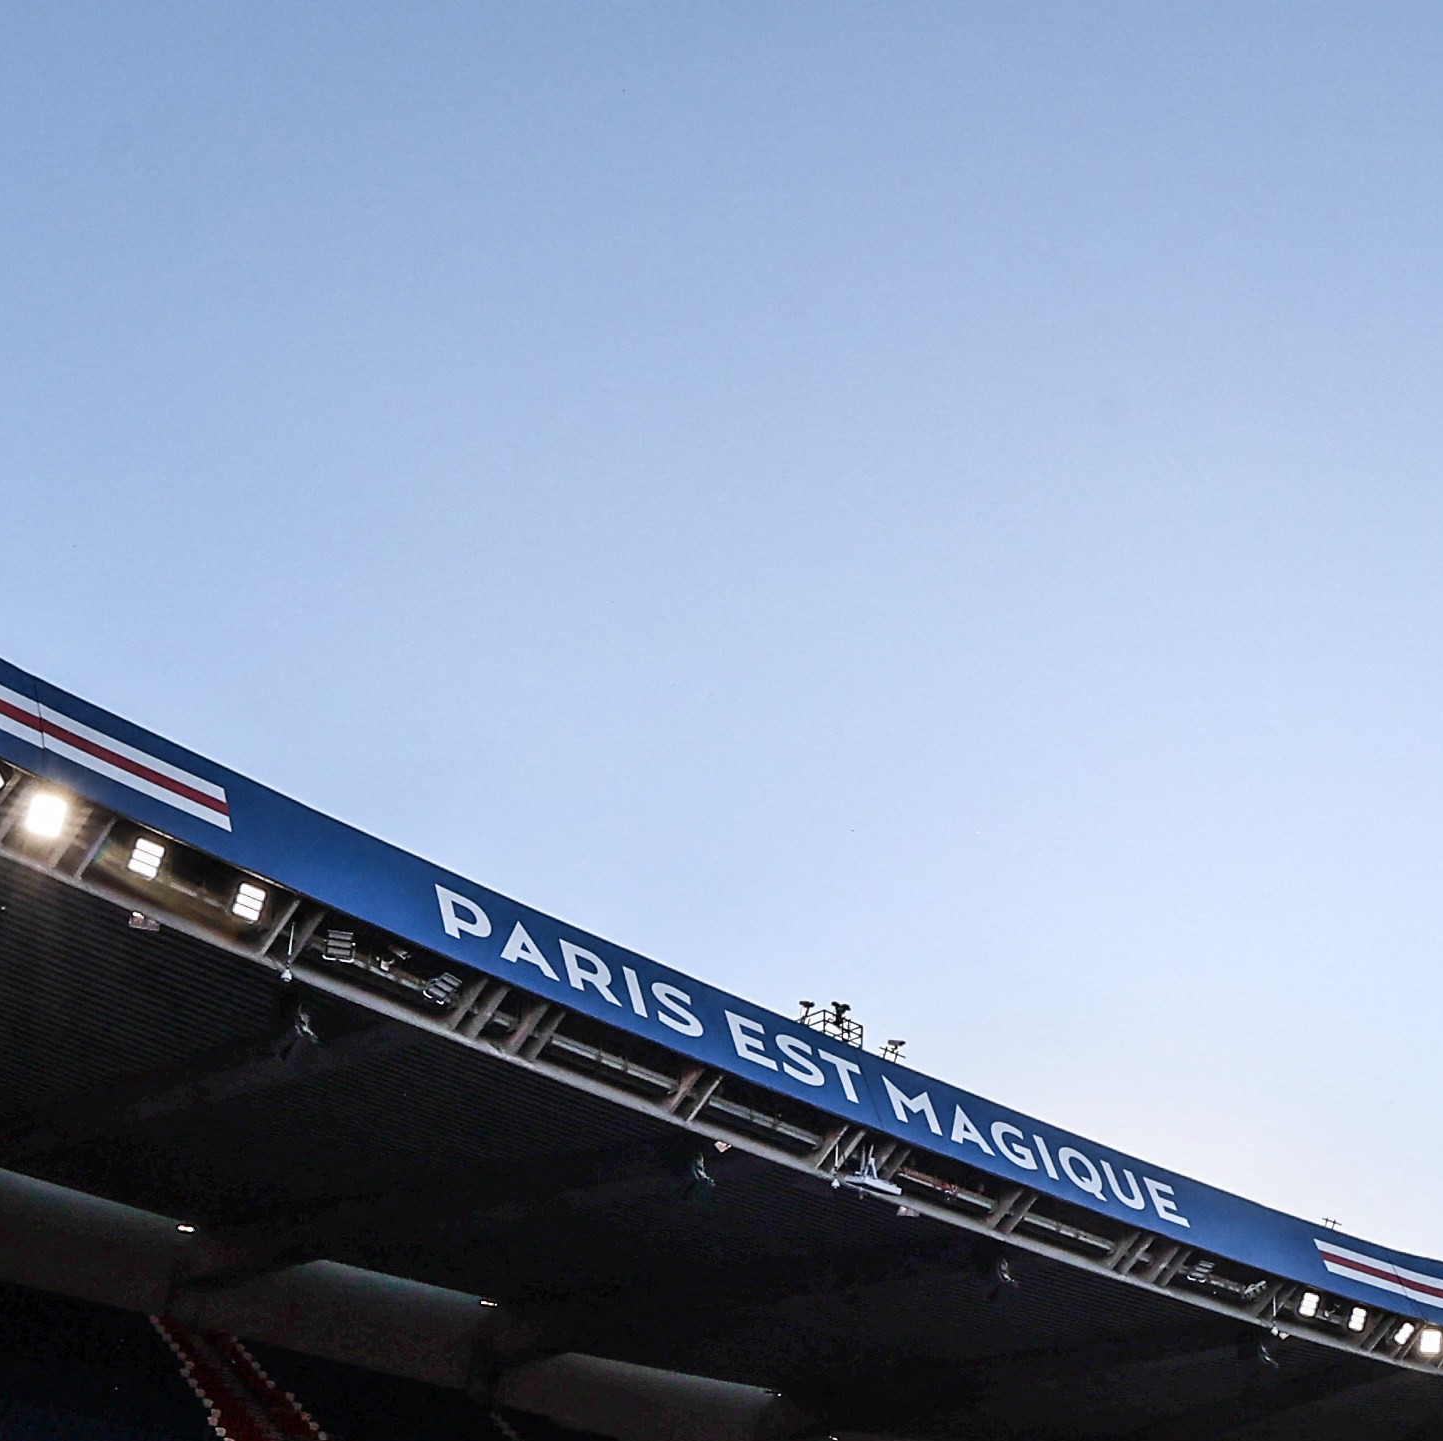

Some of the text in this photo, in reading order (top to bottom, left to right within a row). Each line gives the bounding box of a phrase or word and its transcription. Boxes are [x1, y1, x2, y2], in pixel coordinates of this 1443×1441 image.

[434, 883, 1191, 1228] PARIS EST MAGIQUE
